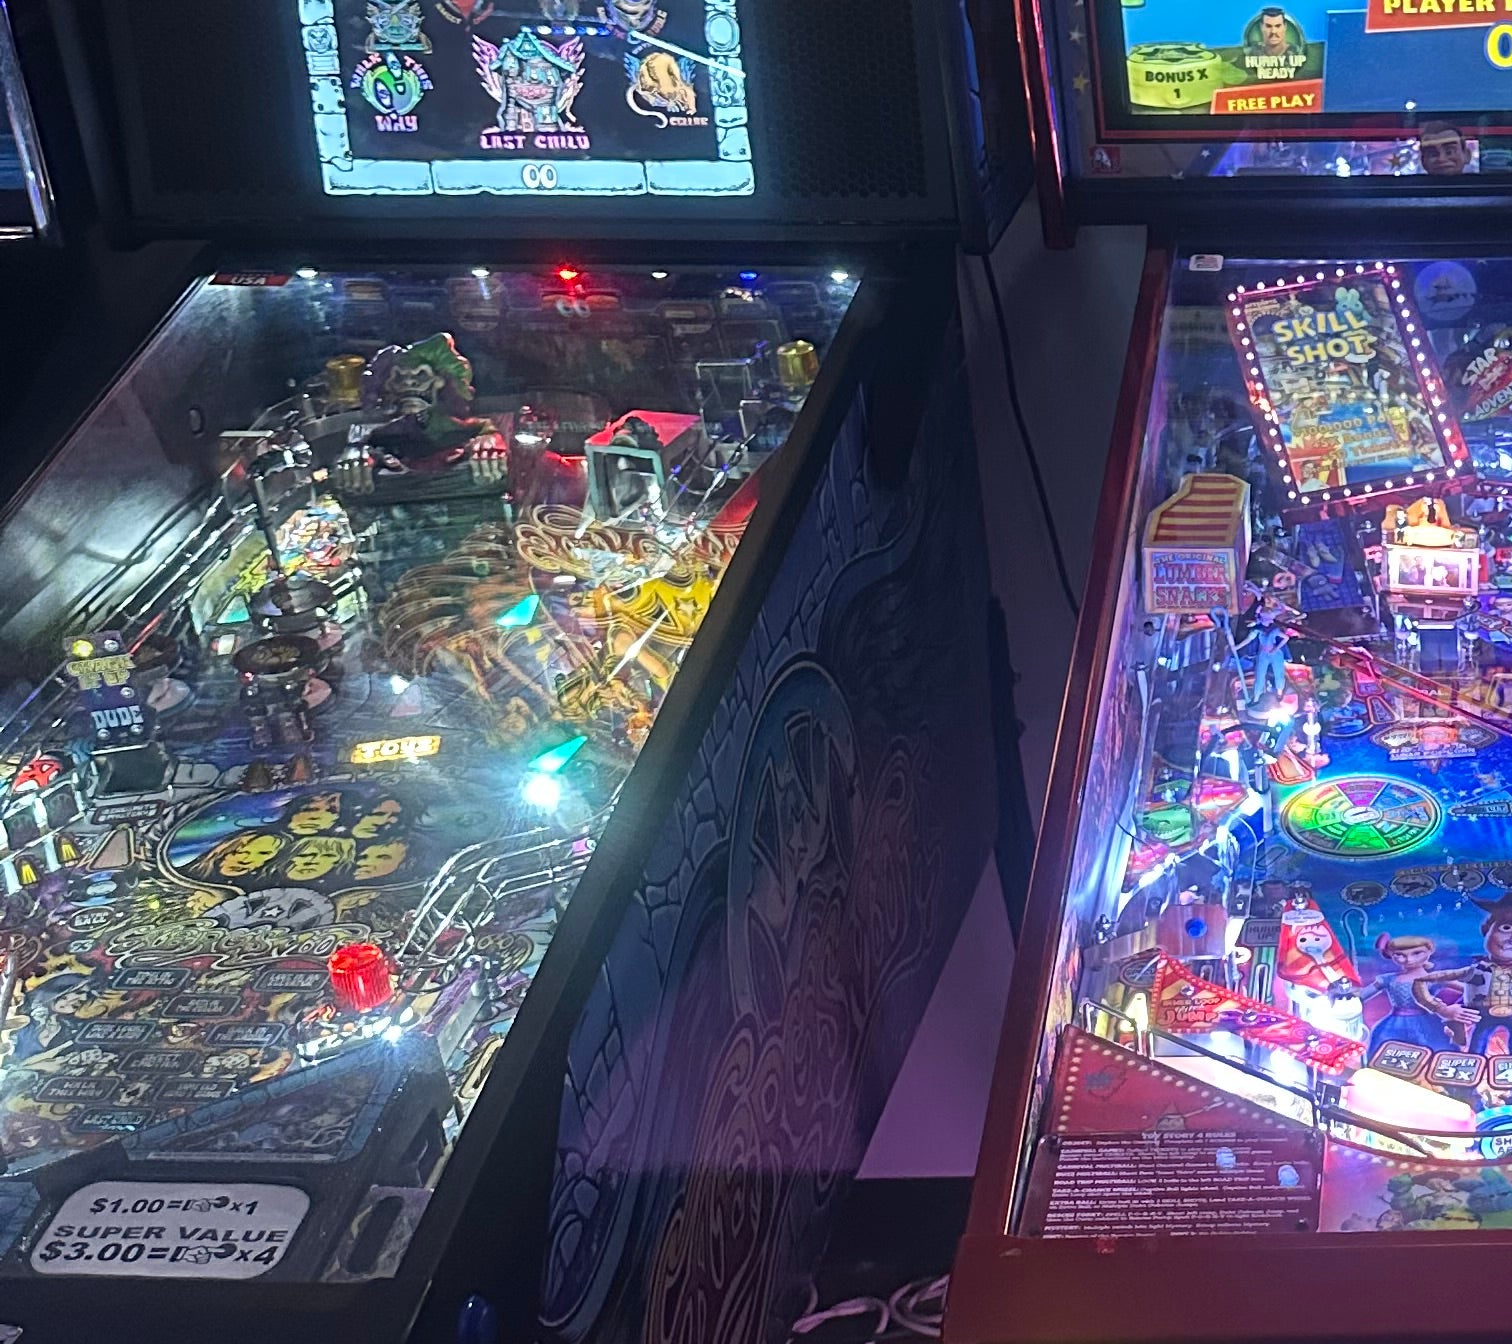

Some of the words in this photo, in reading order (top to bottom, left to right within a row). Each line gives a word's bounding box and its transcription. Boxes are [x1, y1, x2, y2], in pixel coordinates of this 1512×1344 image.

[1245, 55, 1287, 69] HURRY
[1288, 55, 1307, 68] UP
[1144, 69, 1195, 84] BONUS
[1197, 68, 1209, 80] X
[1257, 66, 1297, 80] READY
[1173, 88, 1182, 100] 1
[1227, 96, 1267, 113] FREE
[1269, 93, 1316, 110] PLAY
[374, 114, 419, 133] WAY
[480, 134, 526, 150] LAST
[534, 134, 591, 150] CHILD
[522, 163, 559, 190] 00
[231, 274, 267, 286] USA
[1272, 311, 1369, 343] SKILL
[1286, 335, 1369, 366] SHOT
[1461, 347, 1499, 386] STAR
[90, 705, 144, 729] DUDE
[1384, 1048, 1419, 1060] SUPER
[1440, 1058, 1476, 1069] SUPER
[52, 1224, 168, 1240] SUPER
[178, 1225, 289, 1244] VALUE
